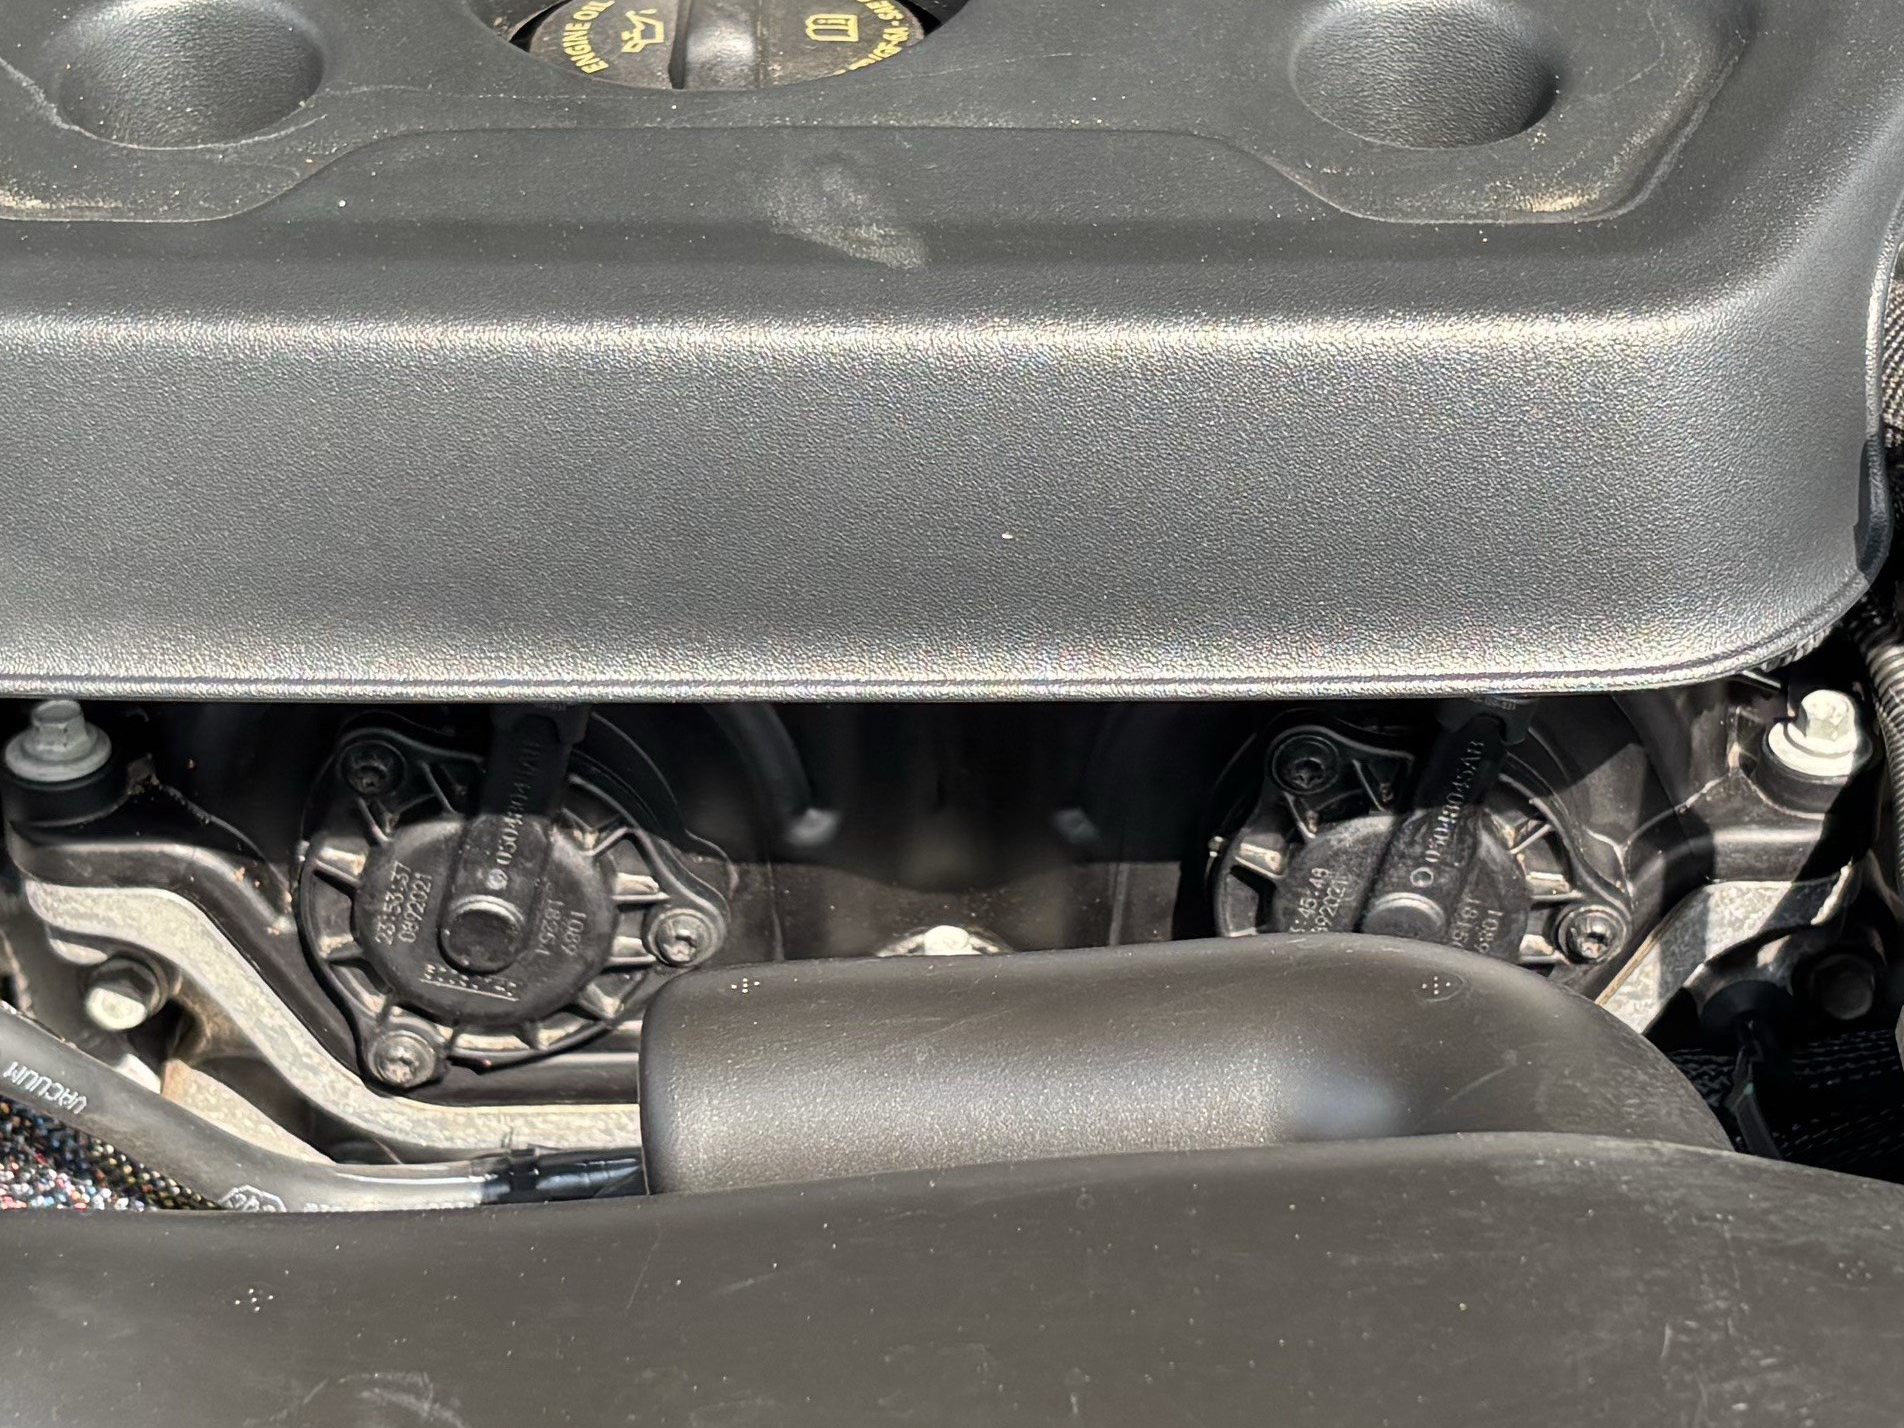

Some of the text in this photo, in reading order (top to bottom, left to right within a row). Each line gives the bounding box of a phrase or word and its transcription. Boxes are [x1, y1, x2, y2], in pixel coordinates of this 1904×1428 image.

[562, 0, 616, 74] ENGINE OIL
[2, 1060, 89, 1115] VACUUM
